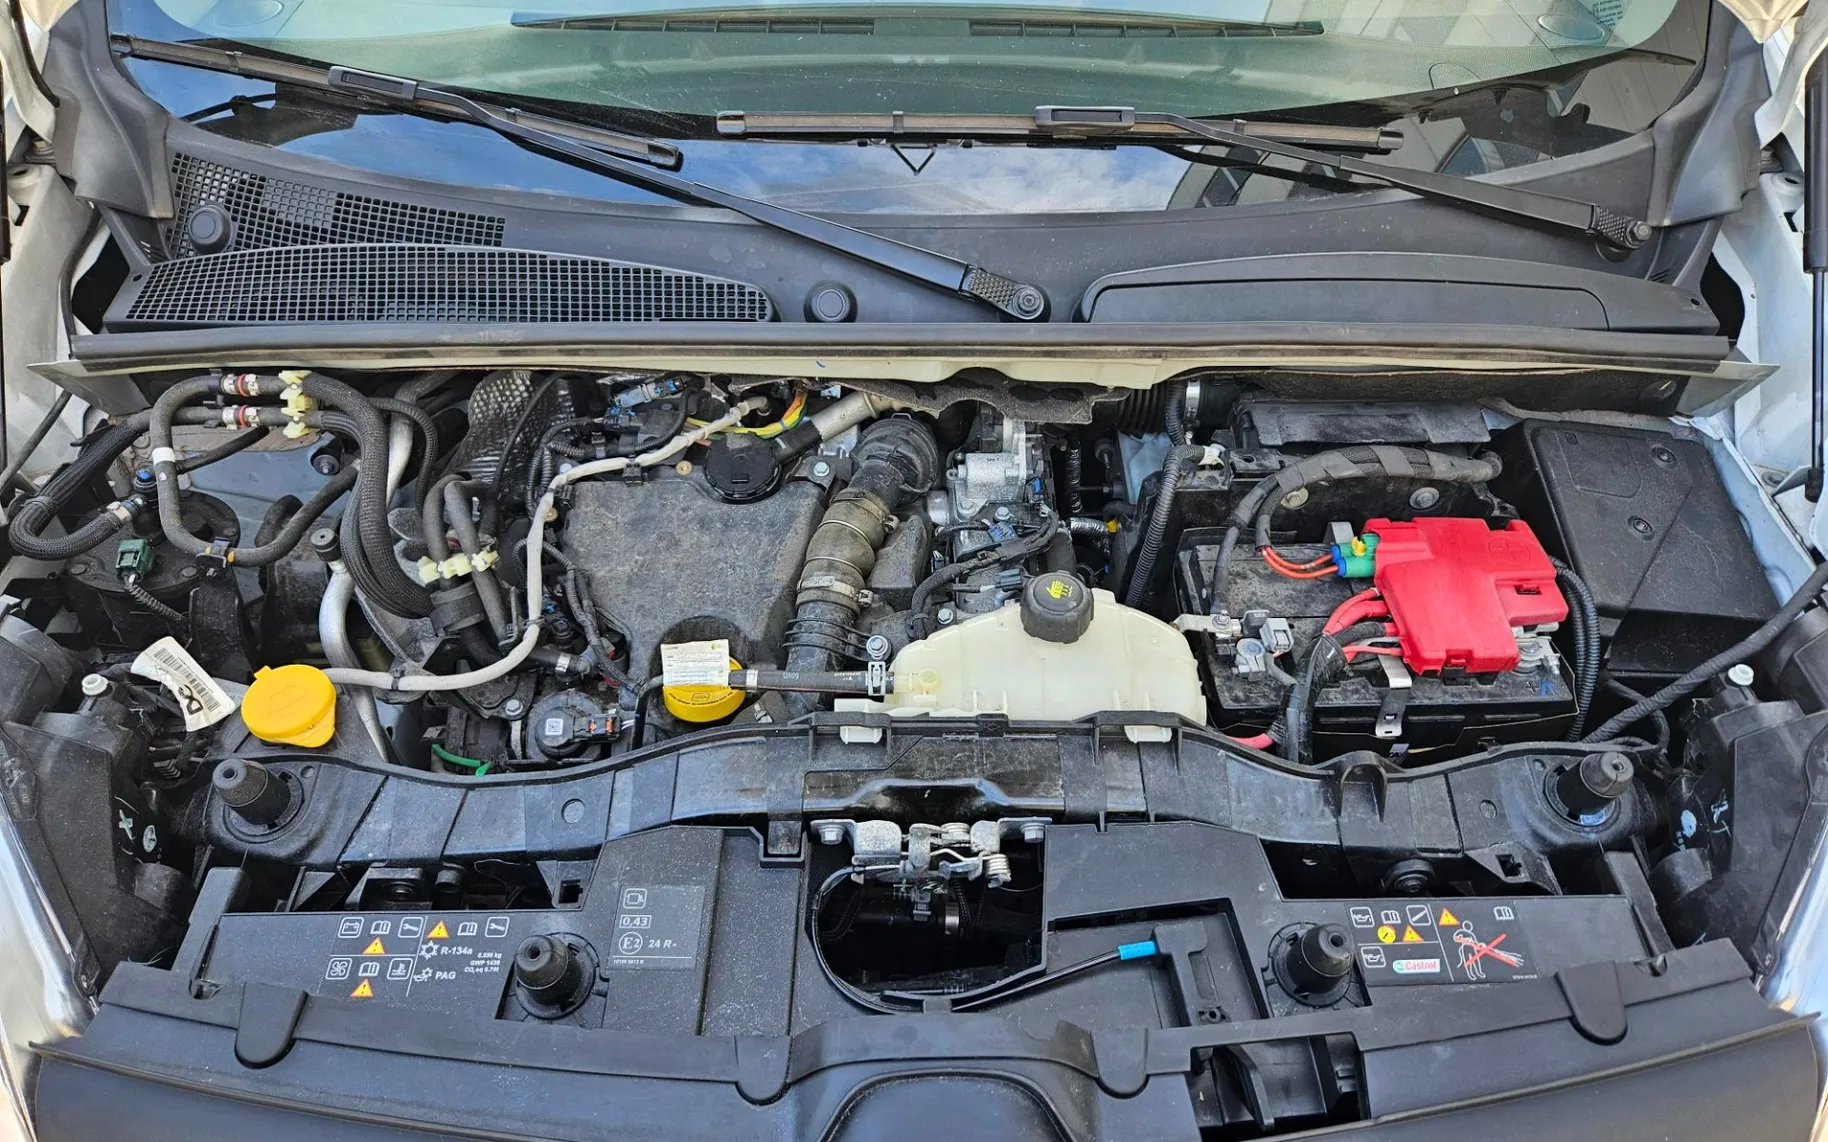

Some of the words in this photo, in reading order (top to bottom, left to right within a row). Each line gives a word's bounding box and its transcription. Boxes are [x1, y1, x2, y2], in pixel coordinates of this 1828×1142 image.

[622, 917, 648, 927] 0,43
[622, 937, 640, 949] E2
[648, 939, 661, 948] 24
[440, 946, 473, 955] R-134a
[1405, 960, 1437, 971] Castrol
[435, 971, 456, 980] PAG
